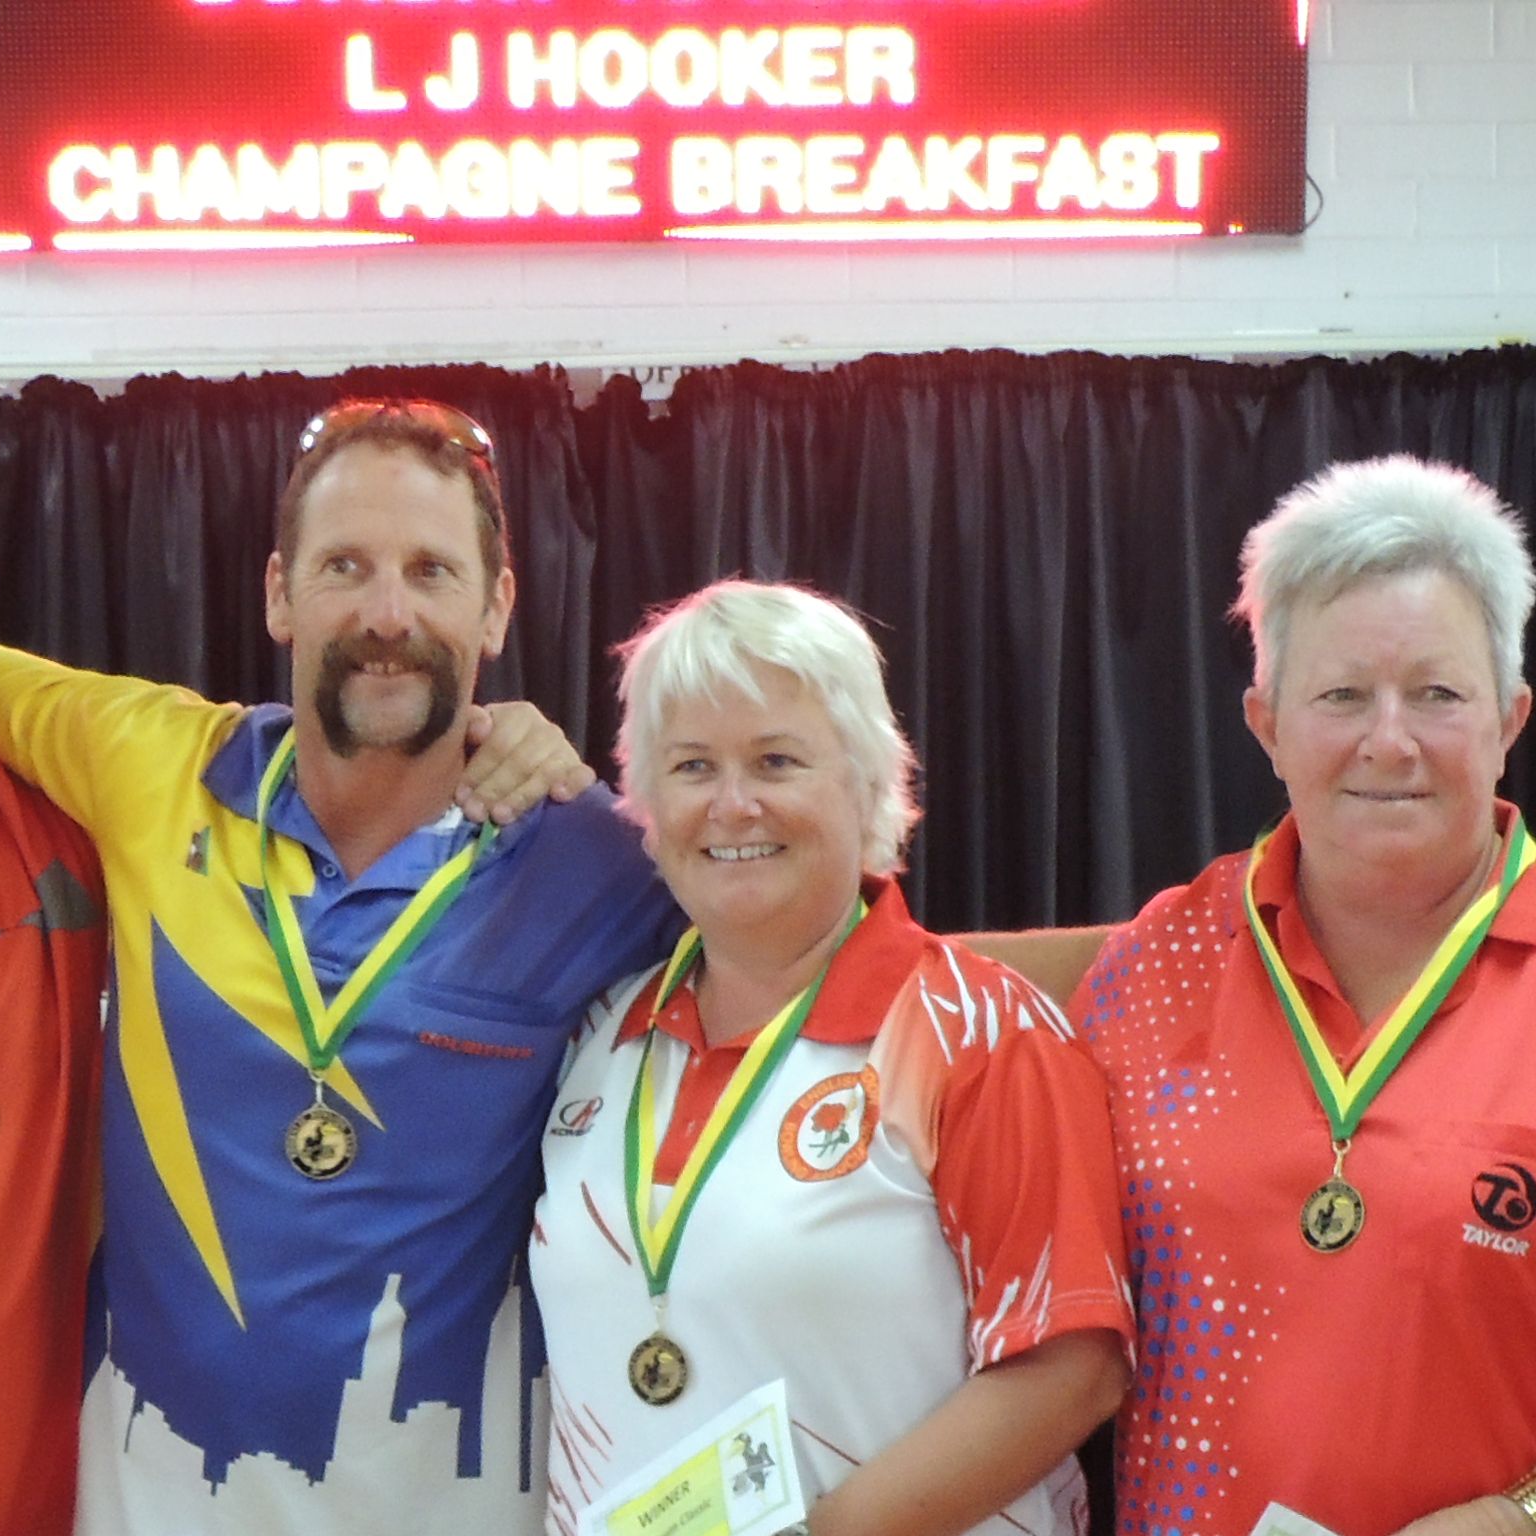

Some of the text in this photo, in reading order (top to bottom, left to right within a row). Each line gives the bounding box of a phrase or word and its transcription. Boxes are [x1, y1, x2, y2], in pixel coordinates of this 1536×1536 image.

[346, 26, 916, 111] L J HOOKER
[47, 130, 1221, 223] CHAMPAGNE BREAKFAST
[1461, 1222, 1531, 1257] TAYLOR
[637, 1480, 690, 1528] WINNER
